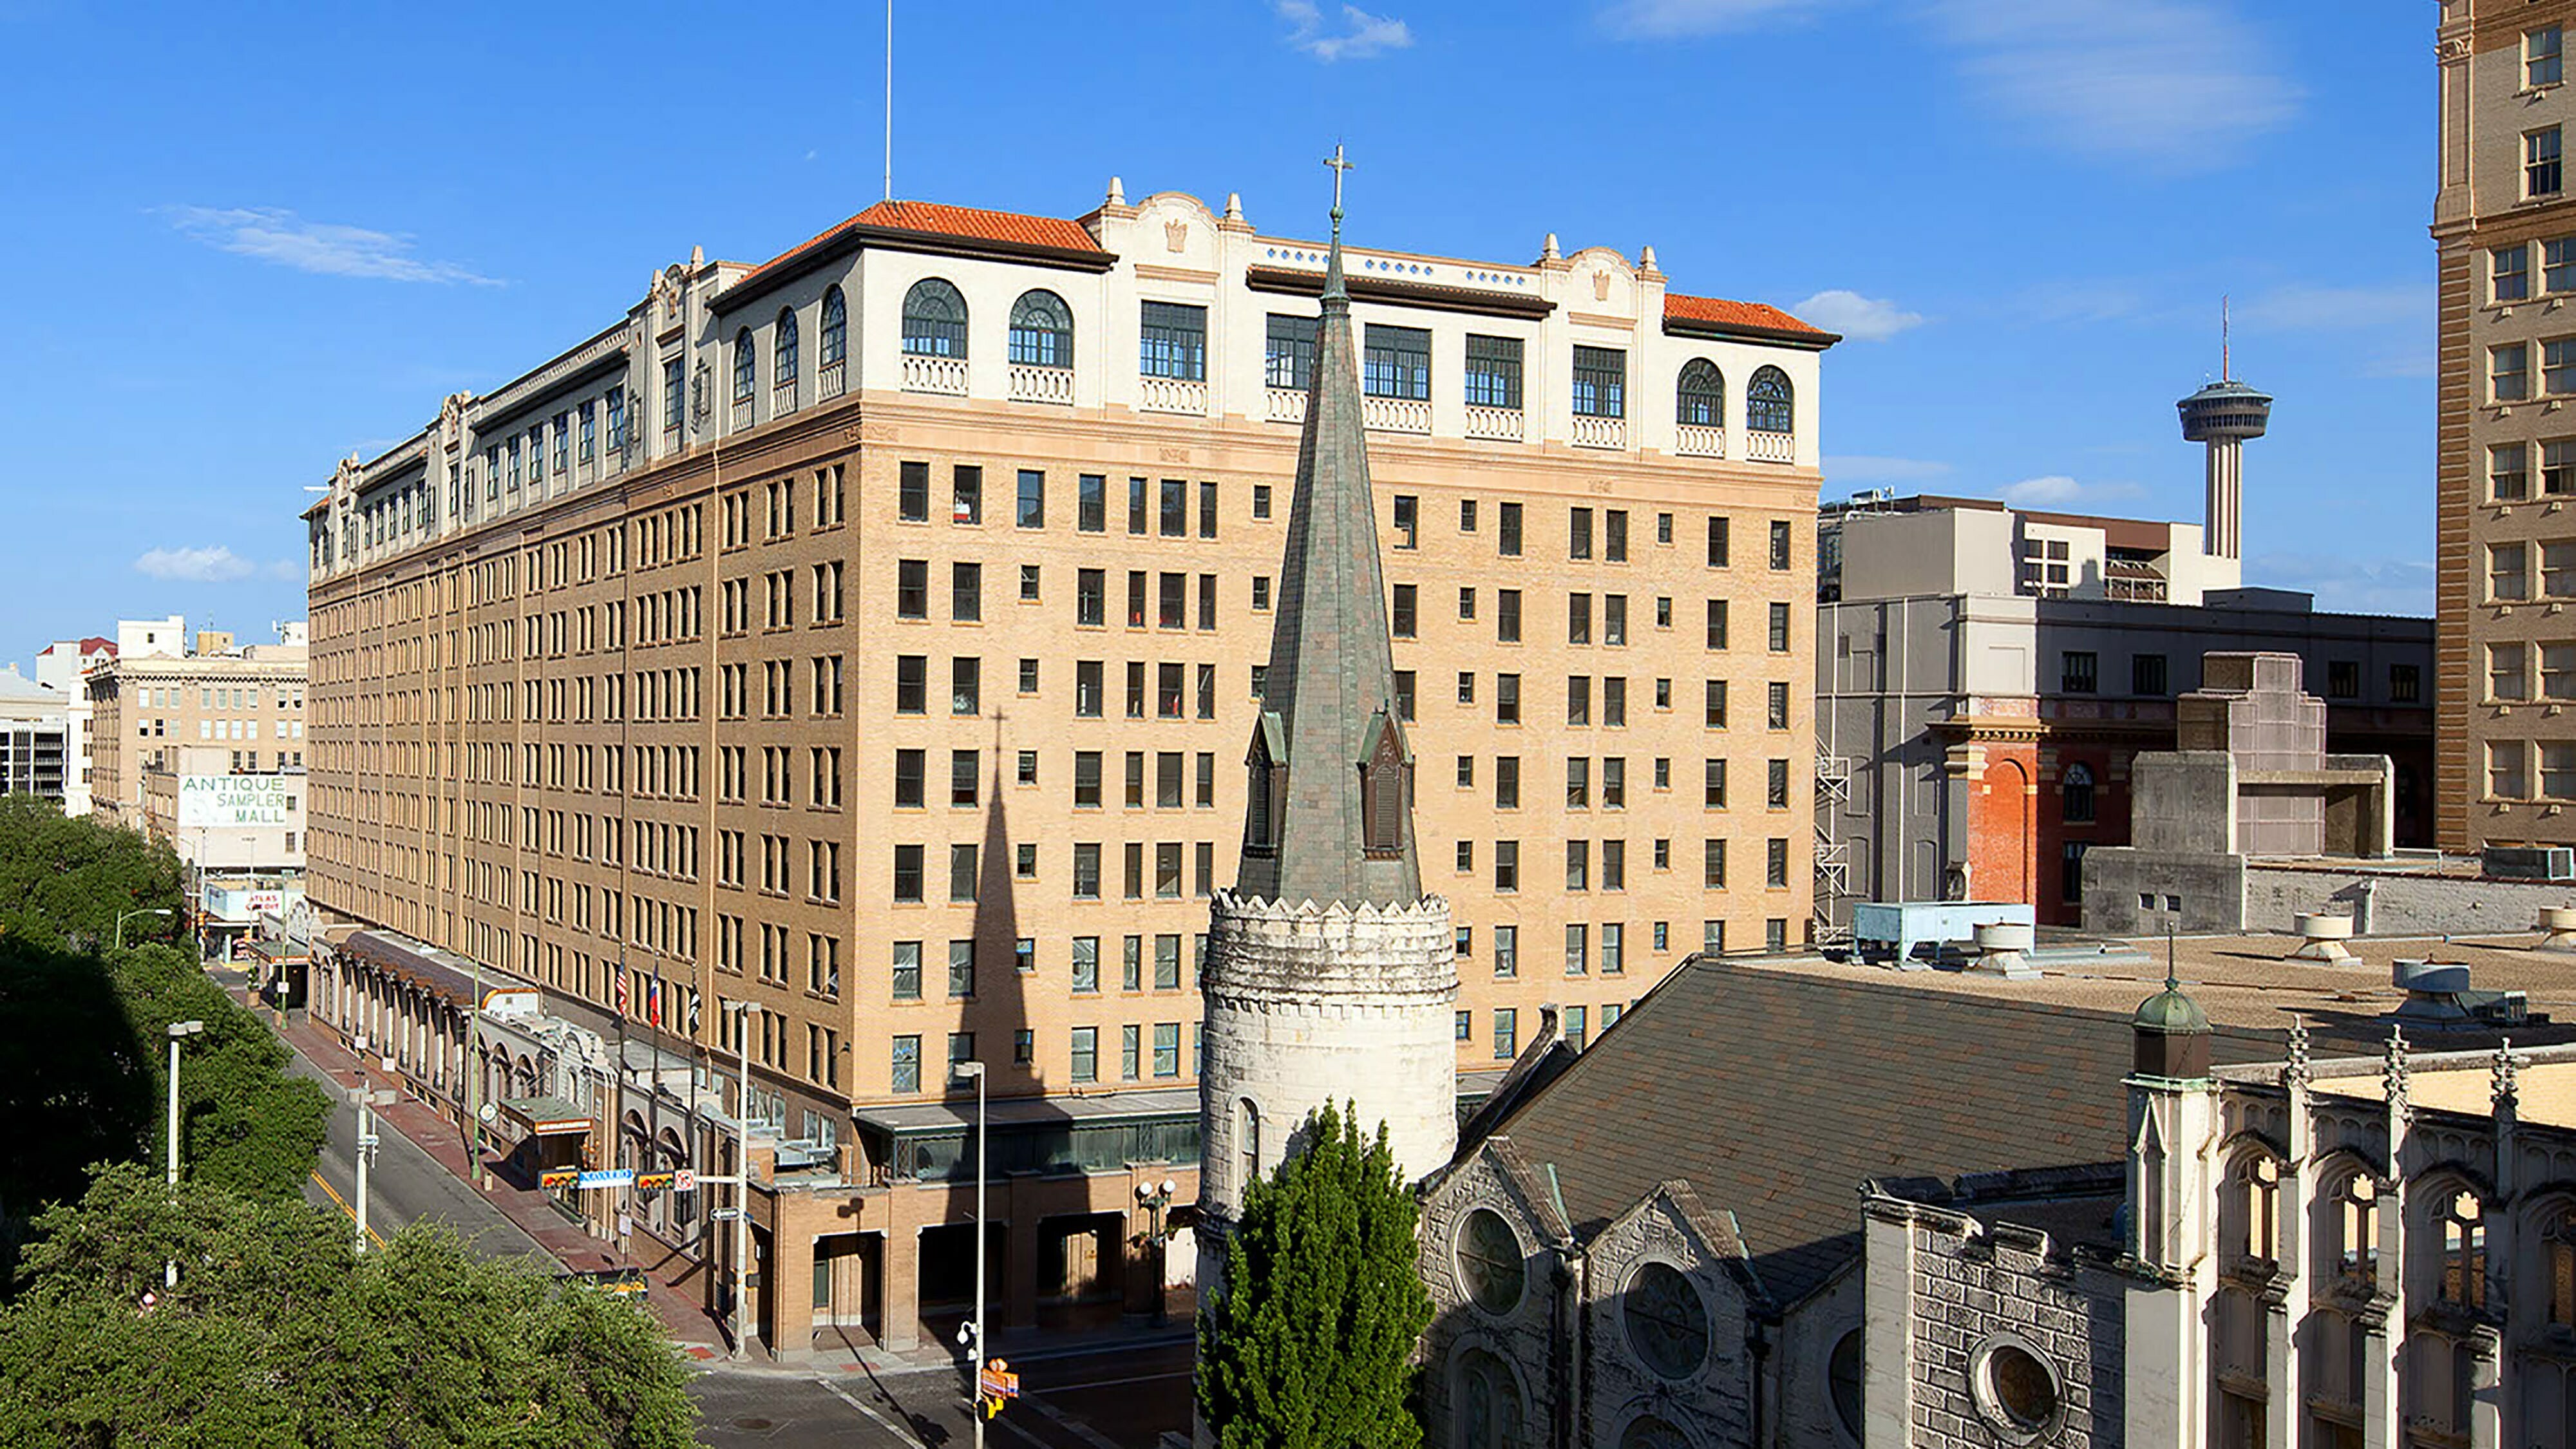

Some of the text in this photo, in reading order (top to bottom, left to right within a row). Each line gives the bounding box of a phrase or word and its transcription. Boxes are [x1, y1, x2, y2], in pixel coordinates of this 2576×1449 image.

[183, 777, 285, 791] ANTIQUE
[217, 793, 285, 807] SAMPLER
[235, 809, 285, 822] MALL
